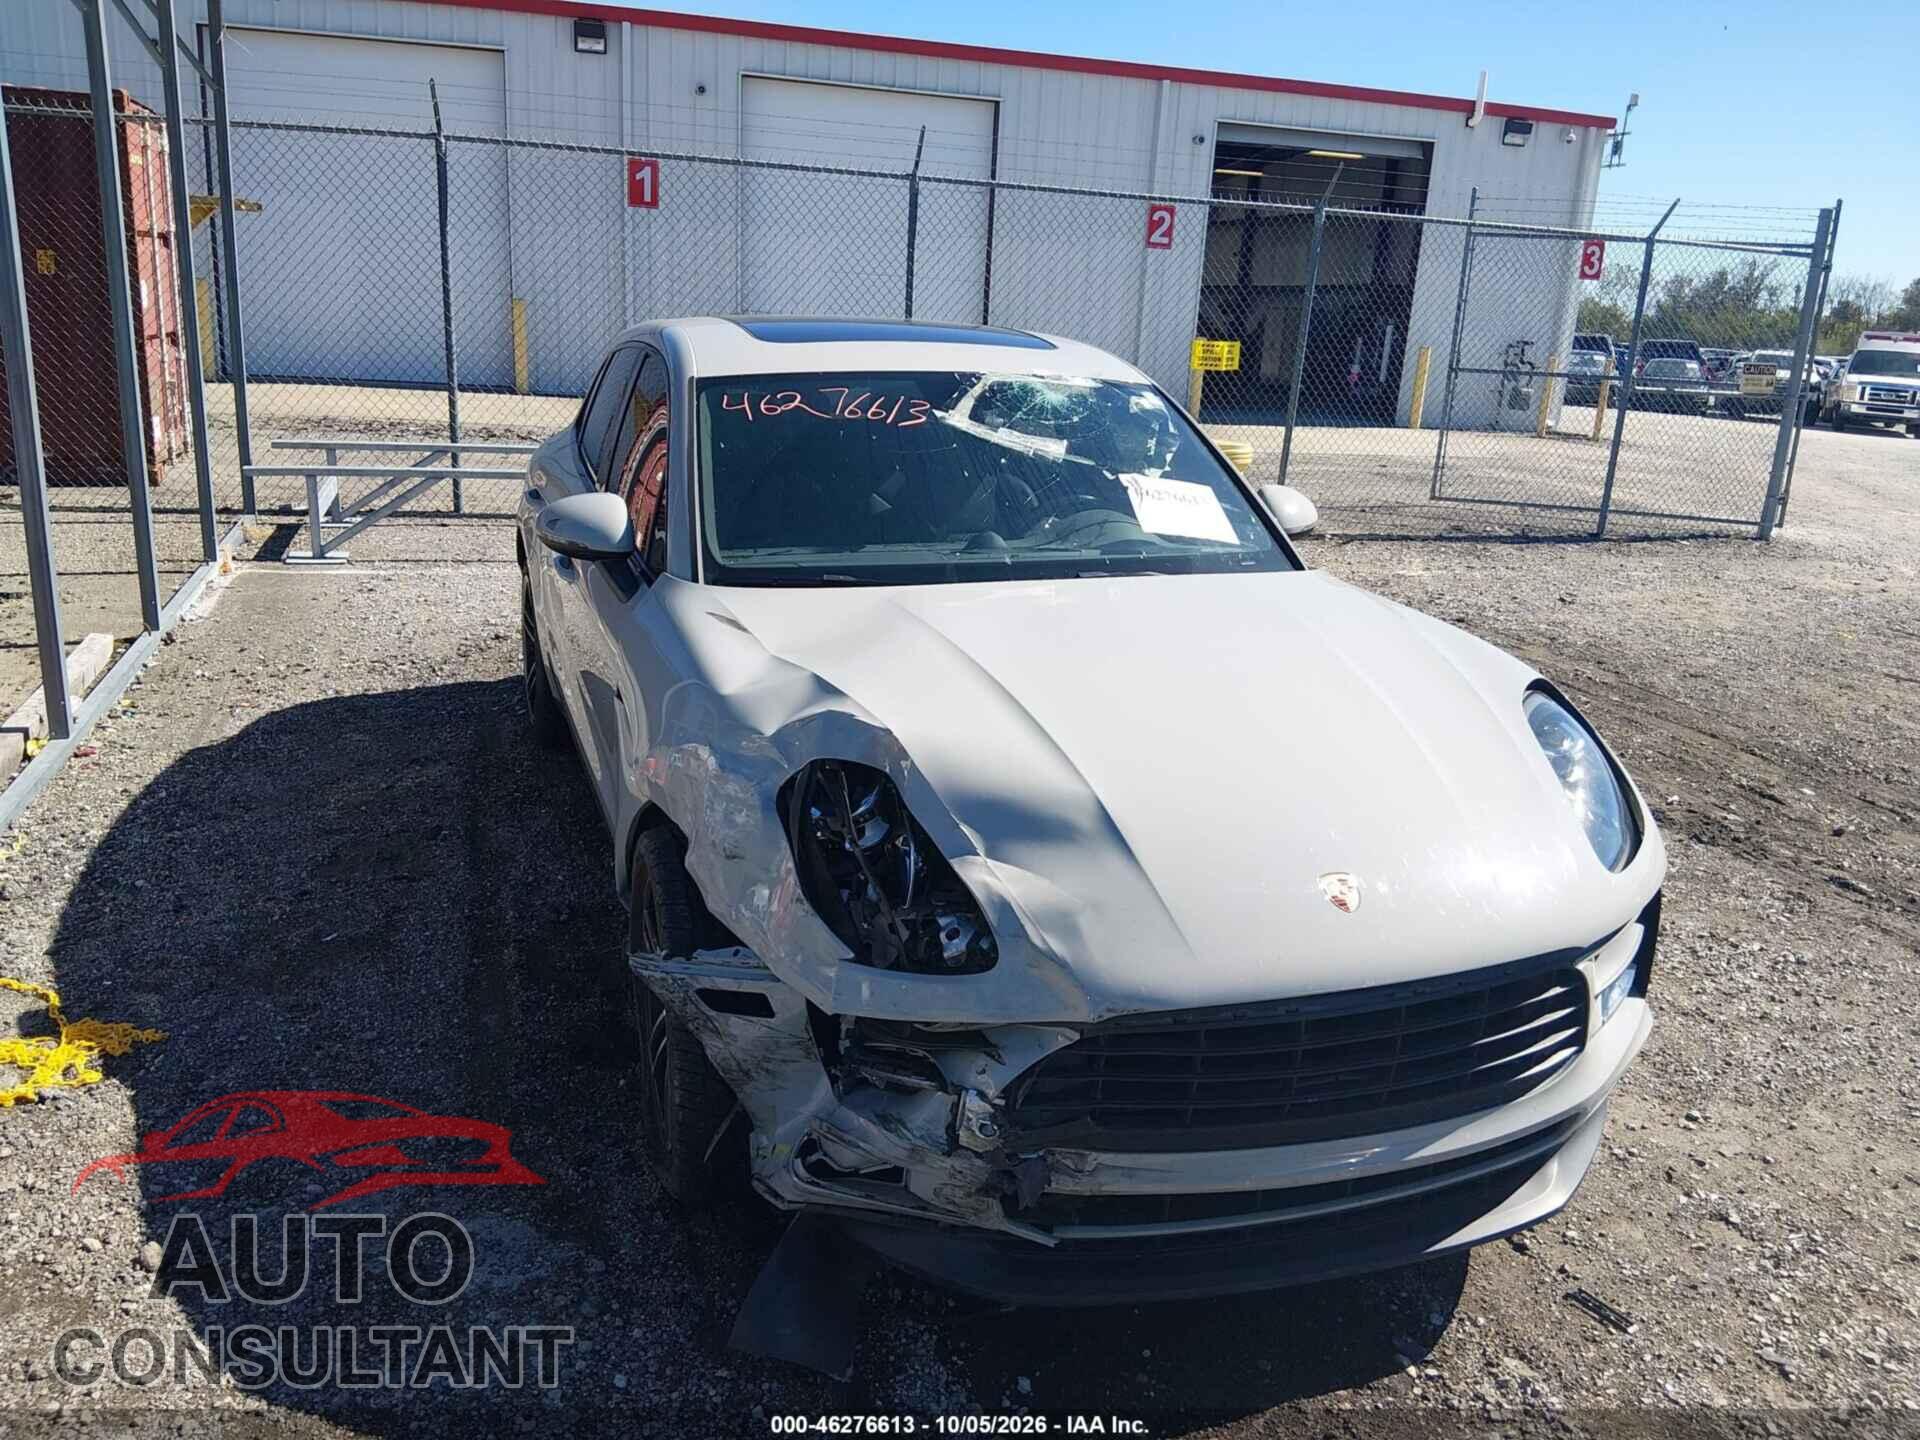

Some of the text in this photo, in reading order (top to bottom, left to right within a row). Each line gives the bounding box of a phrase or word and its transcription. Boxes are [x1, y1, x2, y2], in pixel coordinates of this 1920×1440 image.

[635, 166, 652, 202] 1
[1151, 210, 1171, 243] 2
[1584, 245, 1601, 275] 3
[1744, 365, 1776, 374] CAUTION
[722, 387, 931, 427] 46276613
